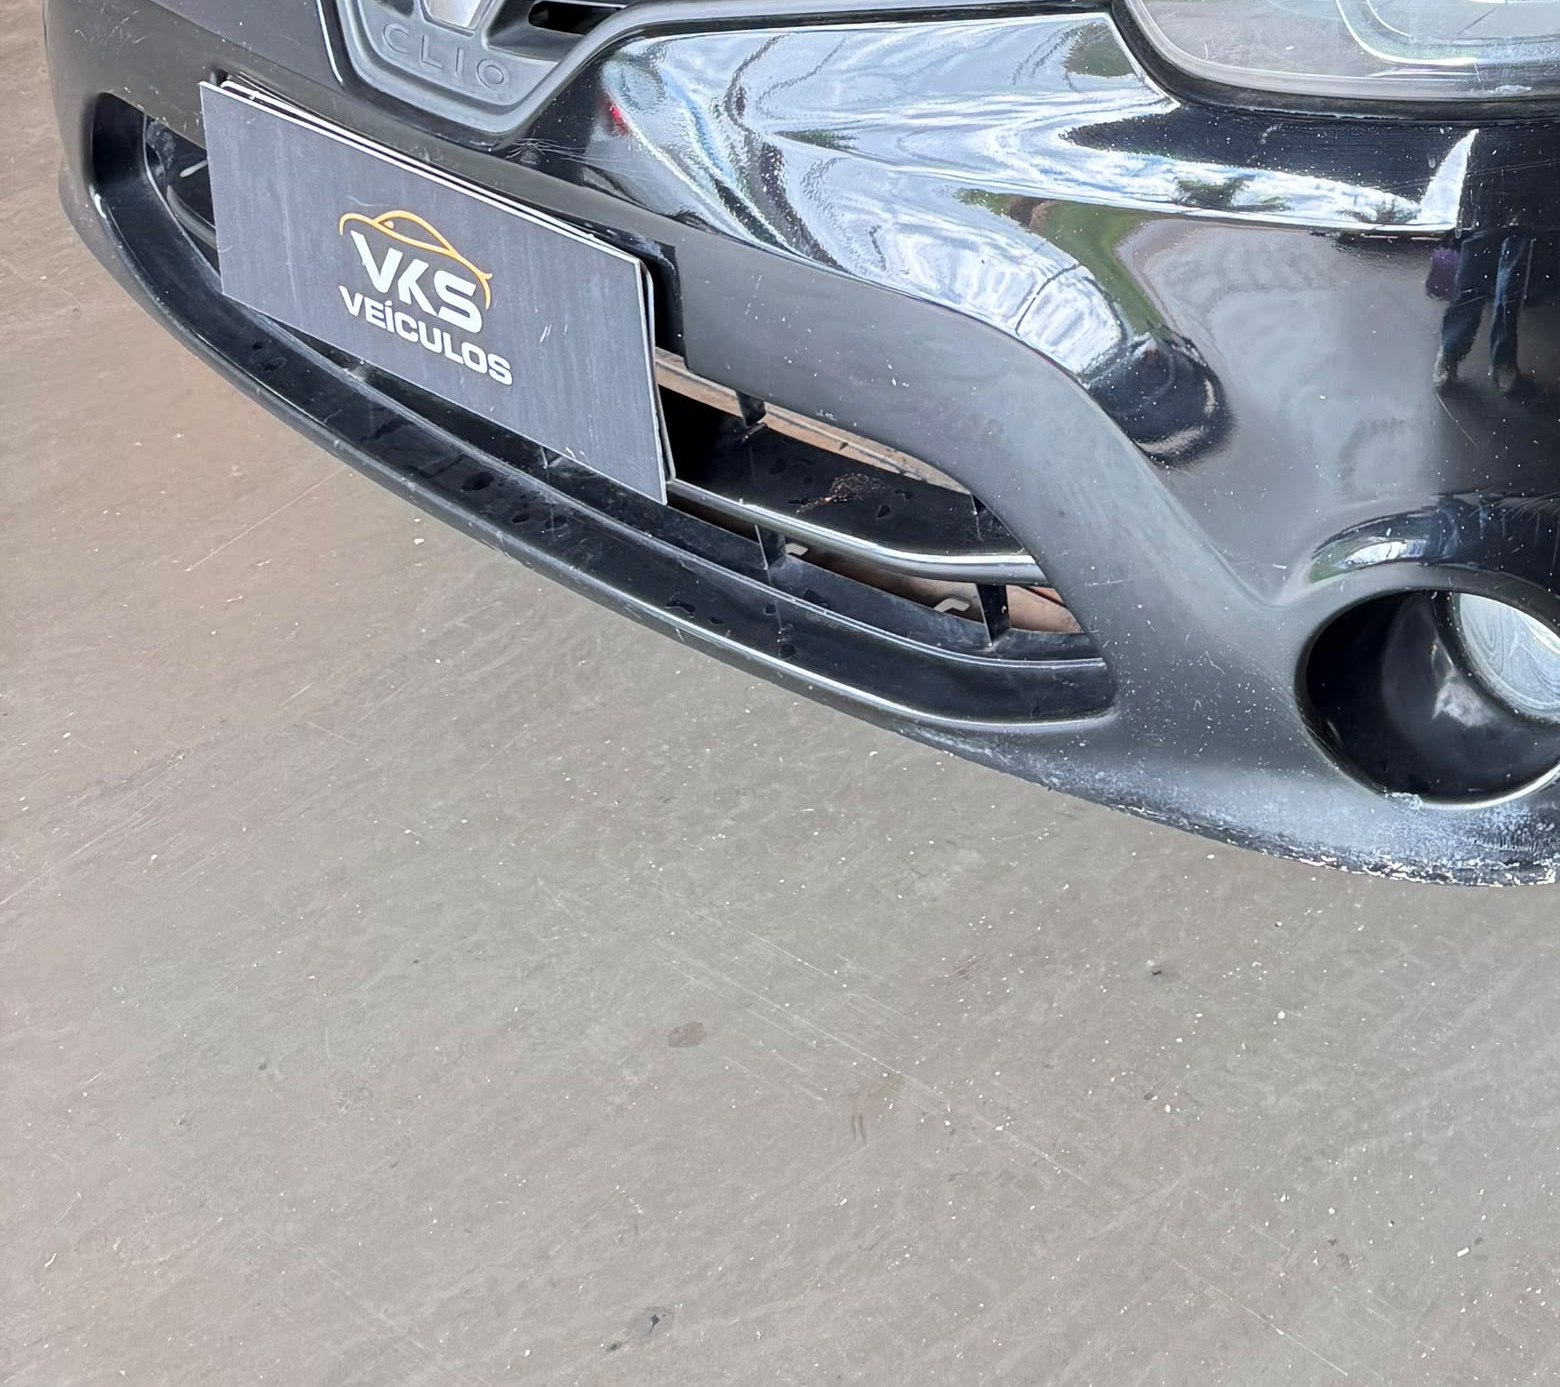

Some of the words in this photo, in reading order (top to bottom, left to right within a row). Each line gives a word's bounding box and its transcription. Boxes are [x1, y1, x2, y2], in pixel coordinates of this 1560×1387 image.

[382, 23, 506, 89] CLIO
[350, 230, 484, 334] VKS
[338, 285, 513, 386] VEÍCULOS
